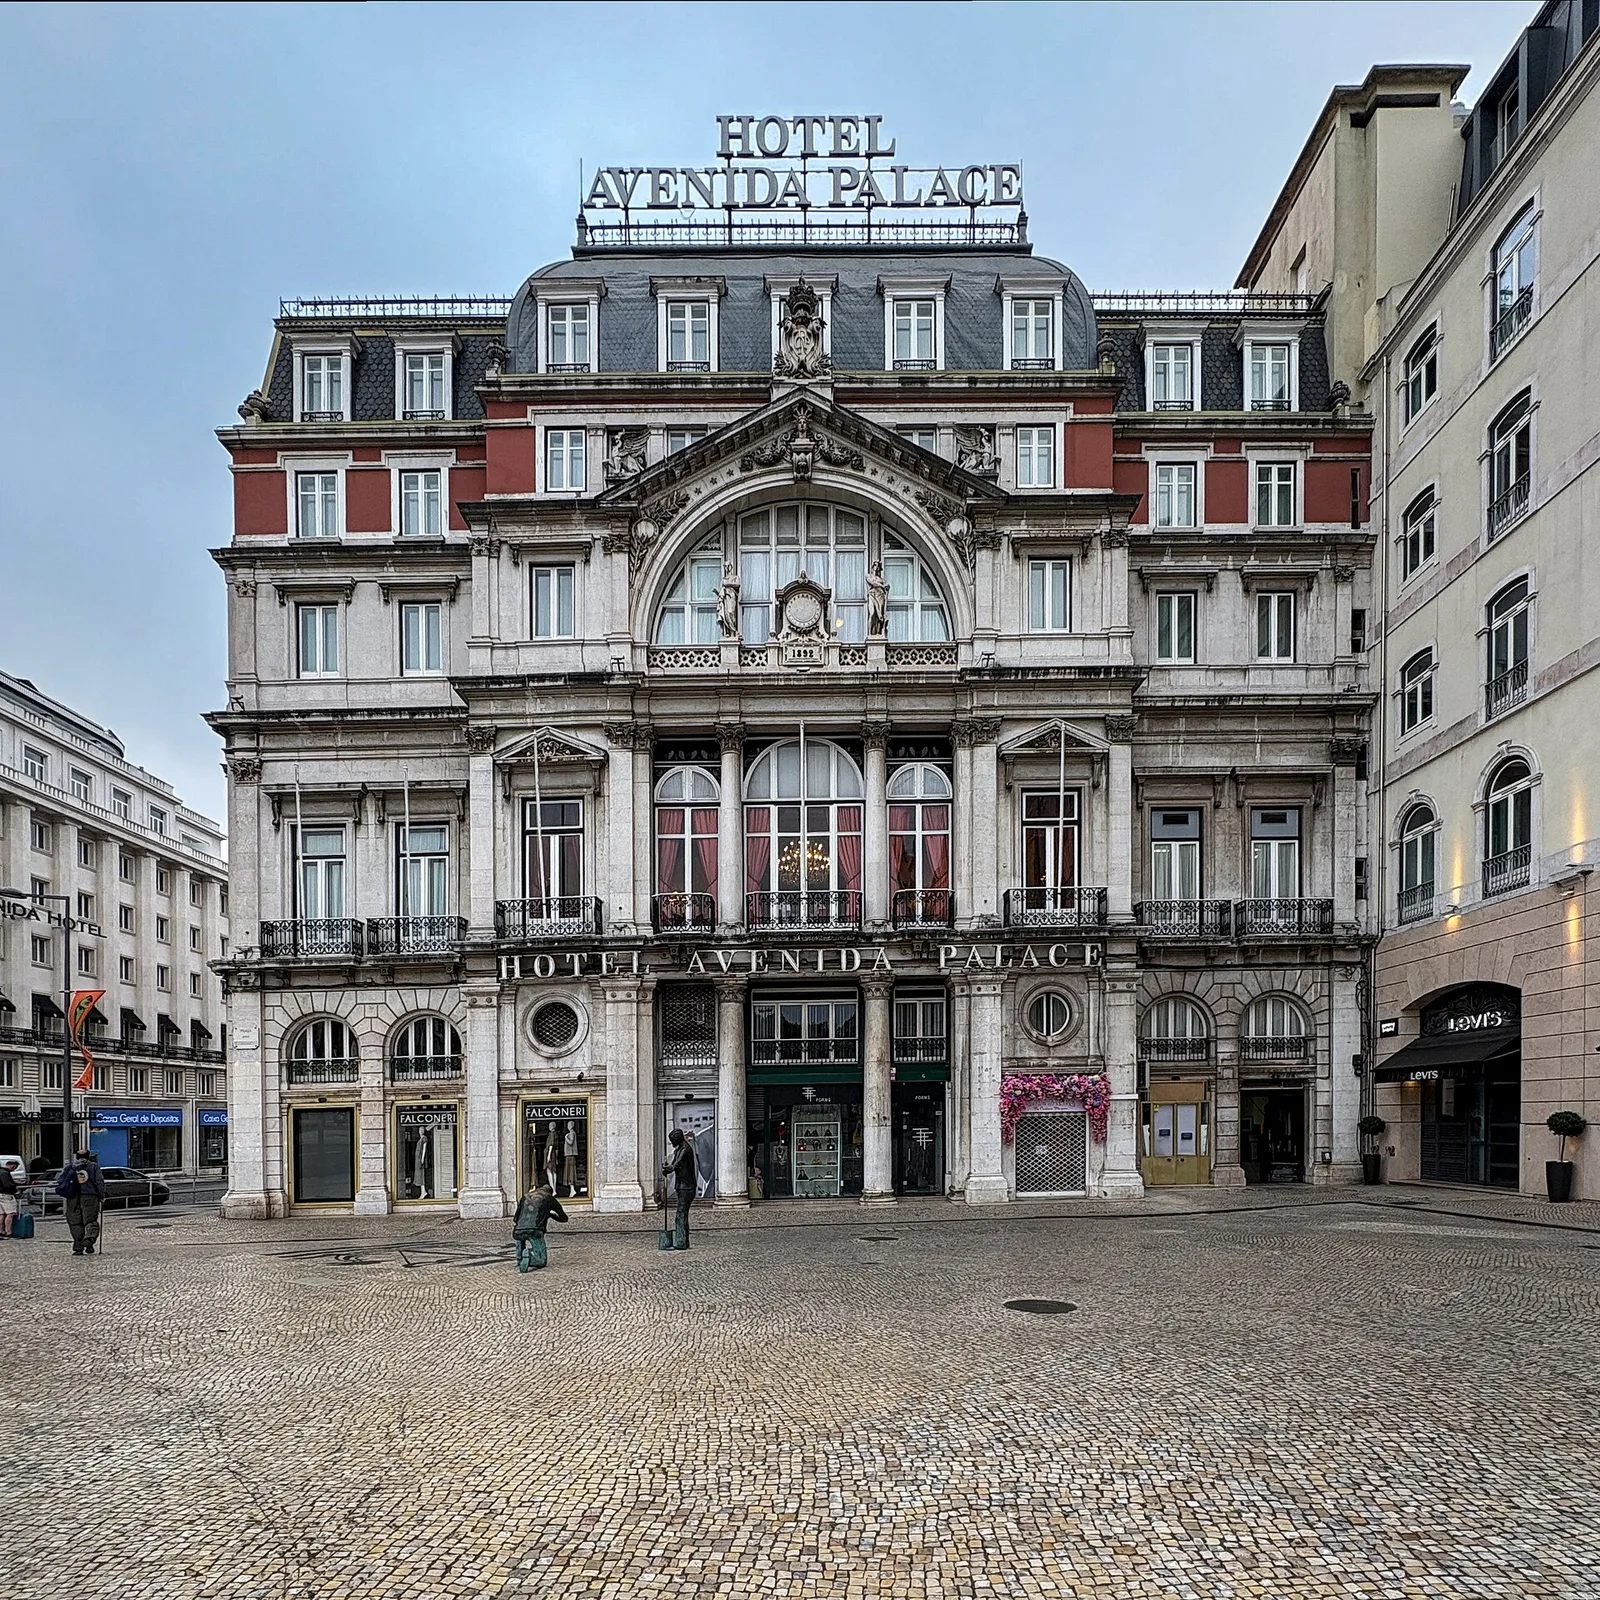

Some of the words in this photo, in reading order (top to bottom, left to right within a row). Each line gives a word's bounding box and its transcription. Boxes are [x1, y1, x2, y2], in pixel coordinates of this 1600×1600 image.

[716, 115, 896, 158] HOTEL
[583, 166, 811, 209] AVENIDA
[828, 164, 1023, 207] PALACE
[792, 649, 814, 658] 1892
[47, 910, 108, 939] HOTEL
[497, 950, 650, 980] HOTEL
[685, 946, 894, 975] AVENIDA
[937, 943, 1103, 970] PALACE
[119, 1113, 139, 1123] Geral
[139, 1114, 149, 1123] de
[400, 1113, 456, 1124] FALCONERI
[525, 1106, 586, 1118] FALCONERI
